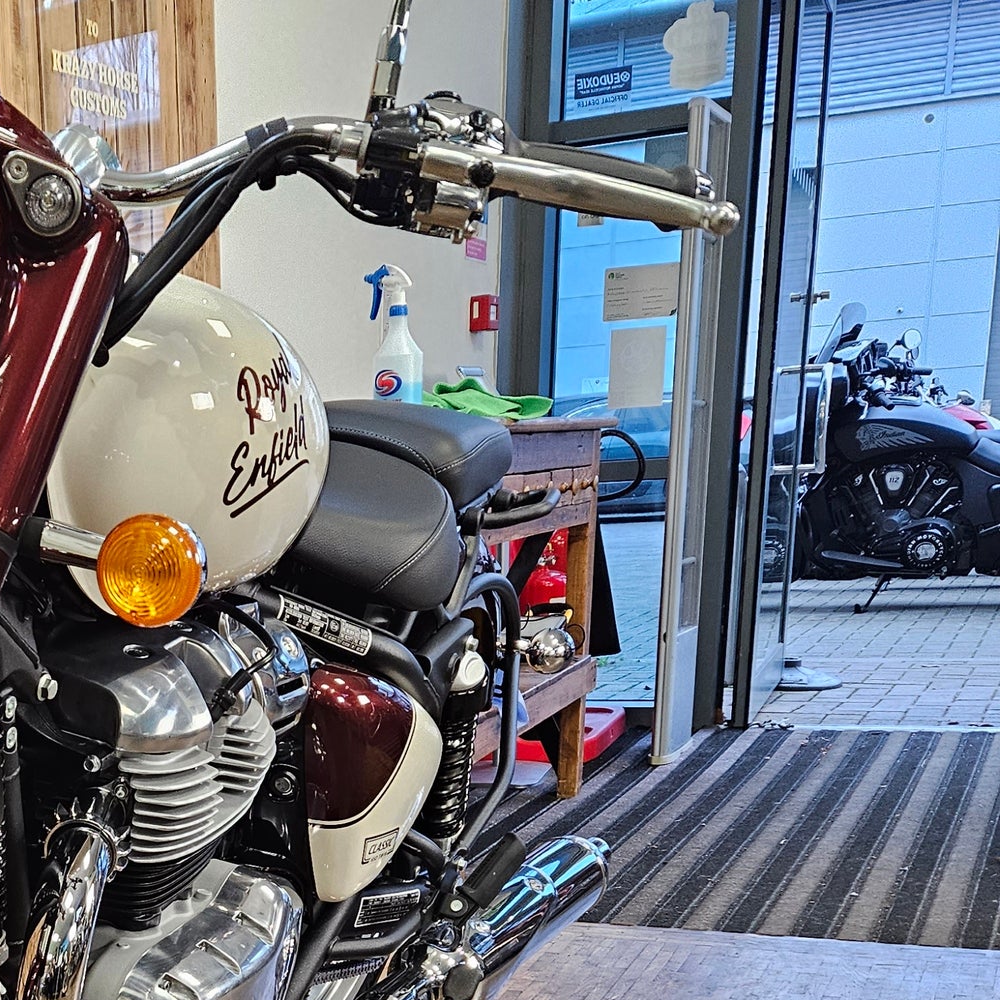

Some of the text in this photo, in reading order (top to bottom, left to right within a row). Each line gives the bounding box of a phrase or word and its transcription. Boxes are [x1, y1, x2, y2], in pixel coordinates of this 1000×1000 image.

[86, 19, 99, 38] TO
[51, 48, 139, 94] KRAZY HORSE
[70, 86, 127, 119] CUSTOMS
[223, 394, 308, 506] Enfield
